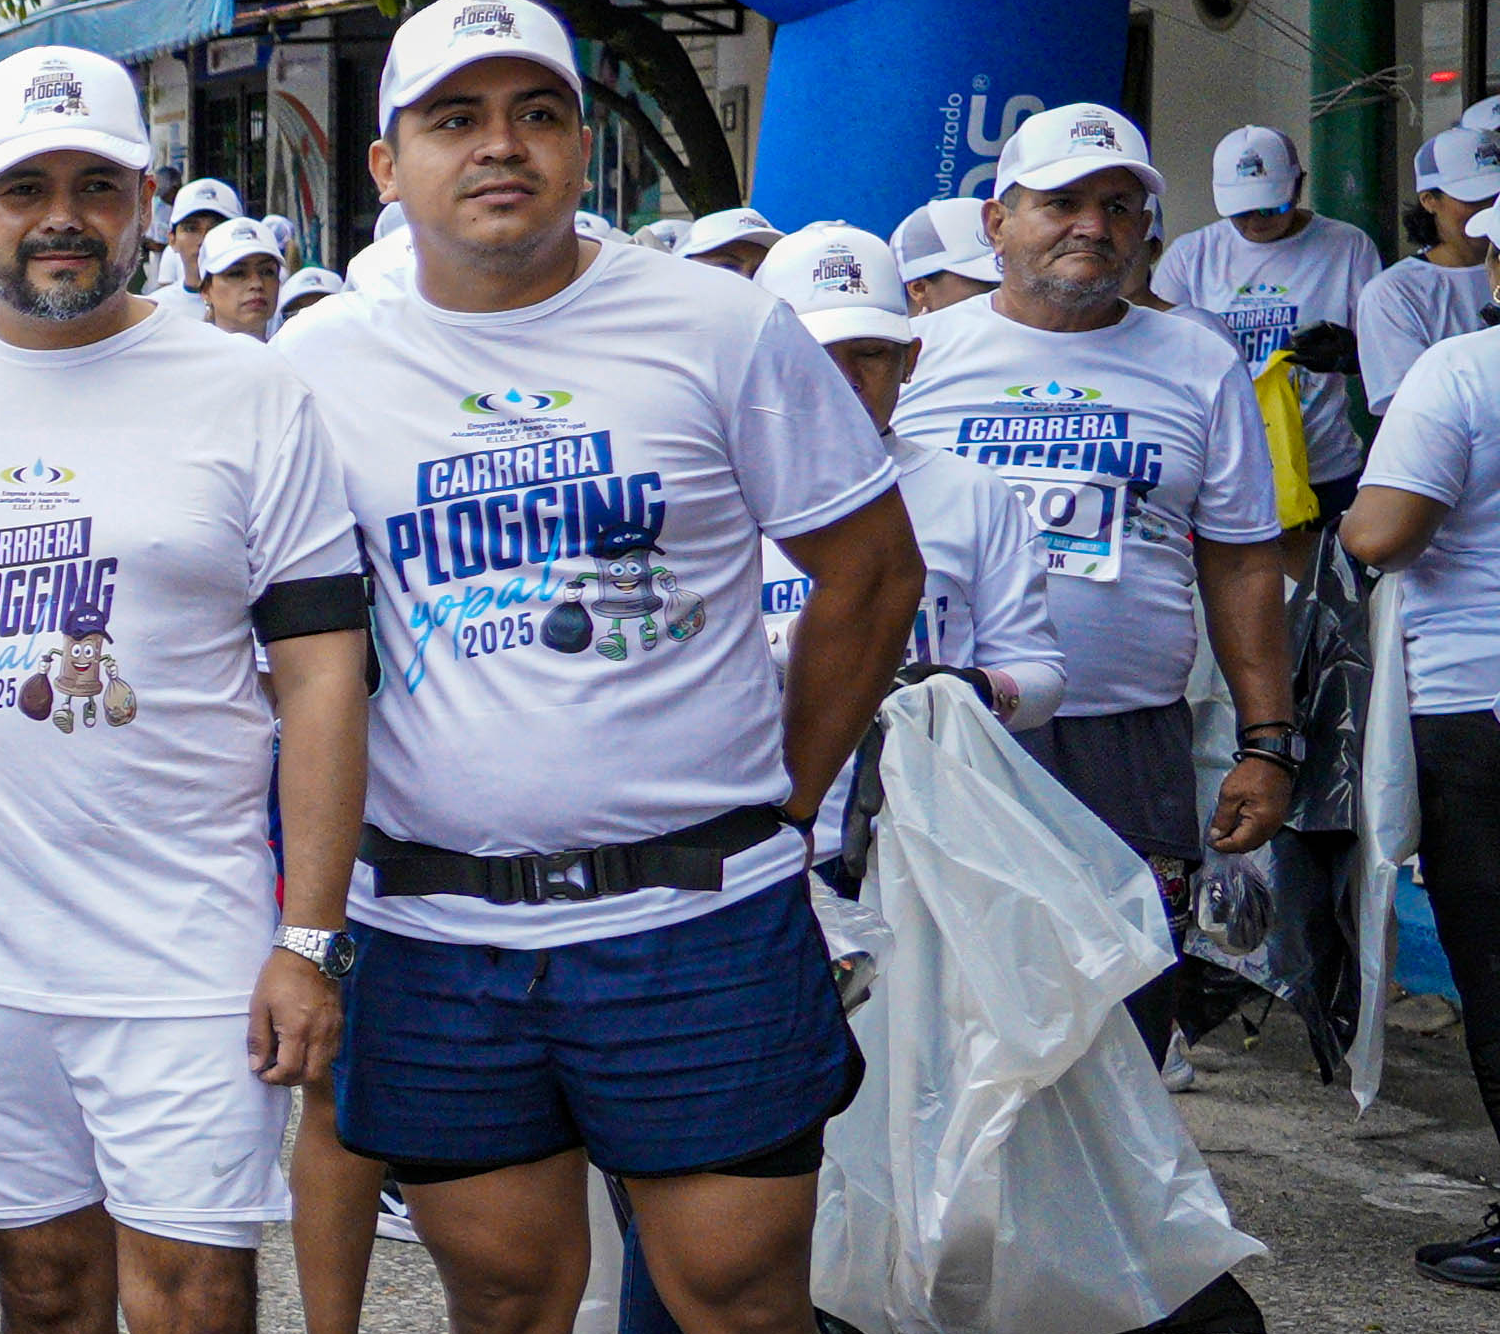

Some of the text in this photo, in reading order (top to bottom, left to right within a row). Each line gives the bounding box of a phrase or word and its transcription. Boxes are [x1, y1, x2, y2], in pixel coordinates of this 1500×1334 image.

[24, 80, 82, 103] PLOGGING
[969, 414, 1117, 441] CARRRERA
[429, 437, 600, 499] CARRRERA
[941, 441, 1163, 491] OGGING
[386, 471, 666, 593] PLOGGING
[405, 518, 564, 695] yopal
[463, 612, 533, 658] 2025
